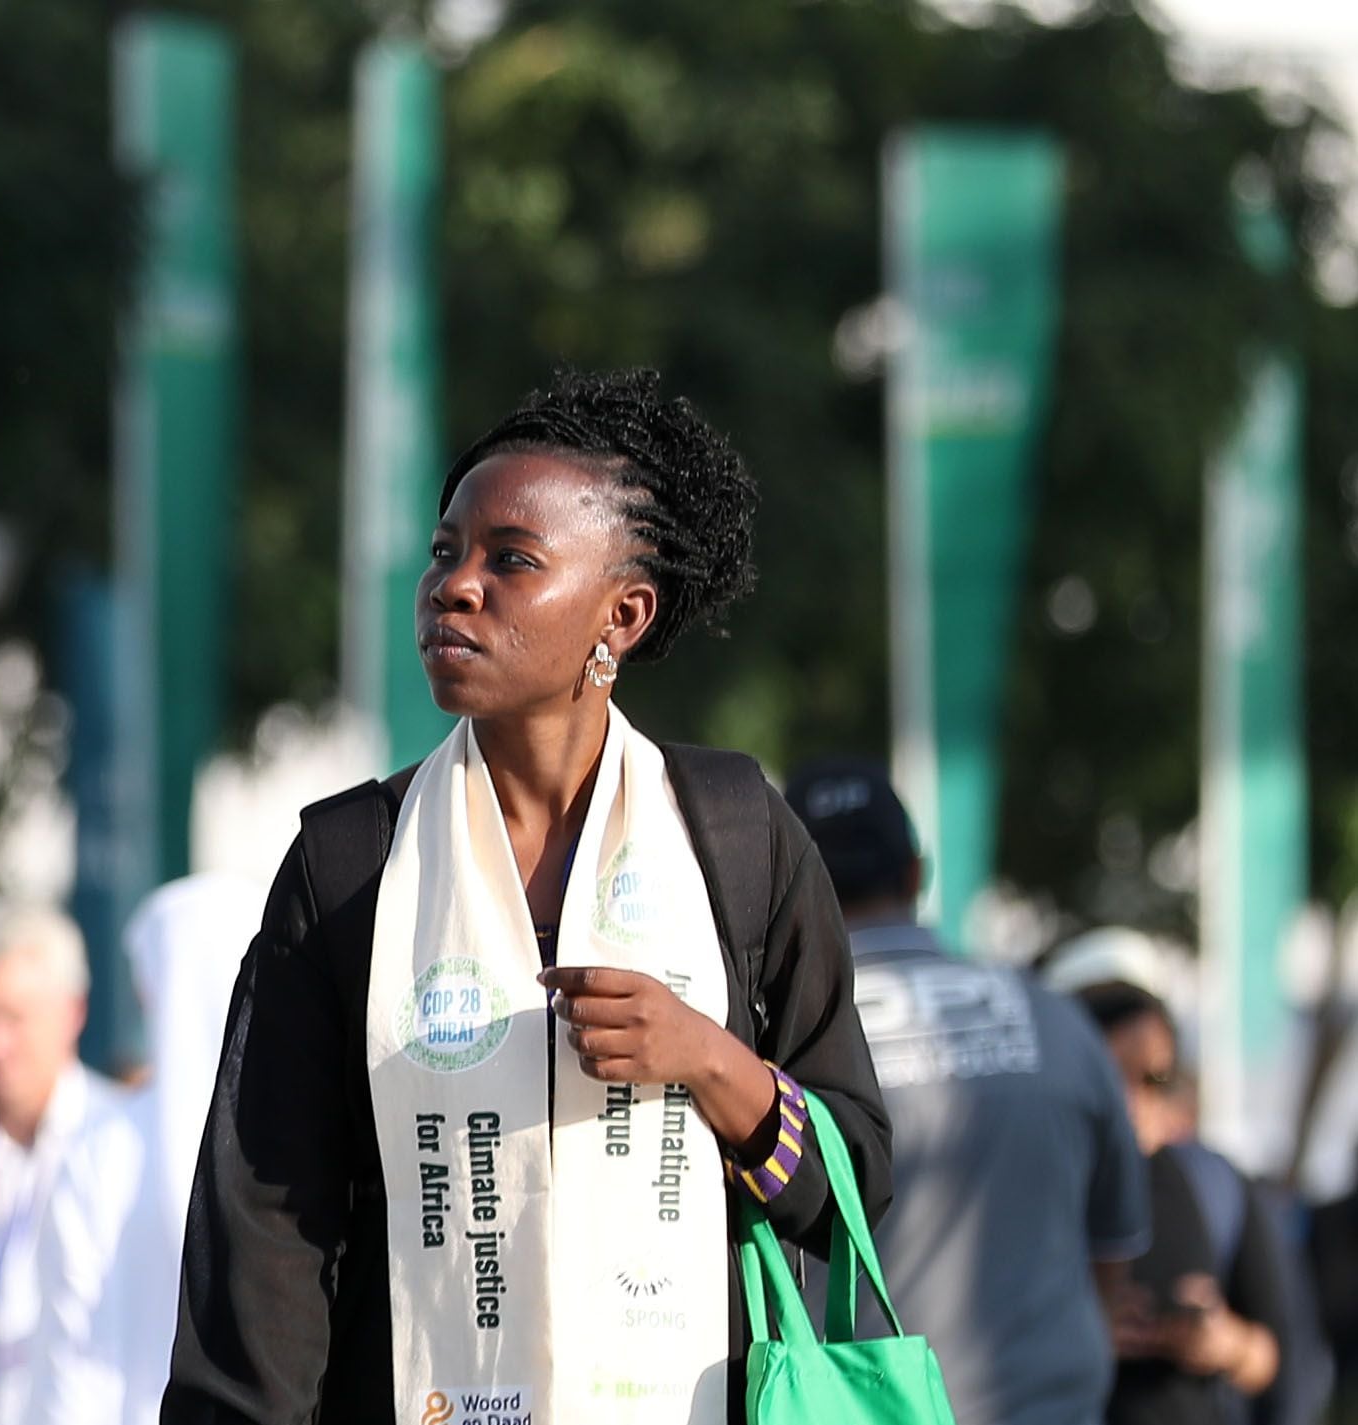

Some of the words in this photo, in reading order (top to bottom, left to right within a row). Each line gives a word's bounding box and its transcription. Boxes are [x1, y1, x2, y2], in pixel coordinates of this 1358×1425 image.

[422, 990, 453, 1018] COP
[459, 987, 481, 1014] 28
[427, 1020, 475, 1045] DUBAI
[416, 1112, 446, 1153] for
[466, 1110, 502, 1222] Climate
[419, 1162, 451, 1248] Africa
[465, 1230, 506, 1329] justice
[625, 1307, 687, 1330] SPONG
[461, 1392, 520, 1413] Woord
